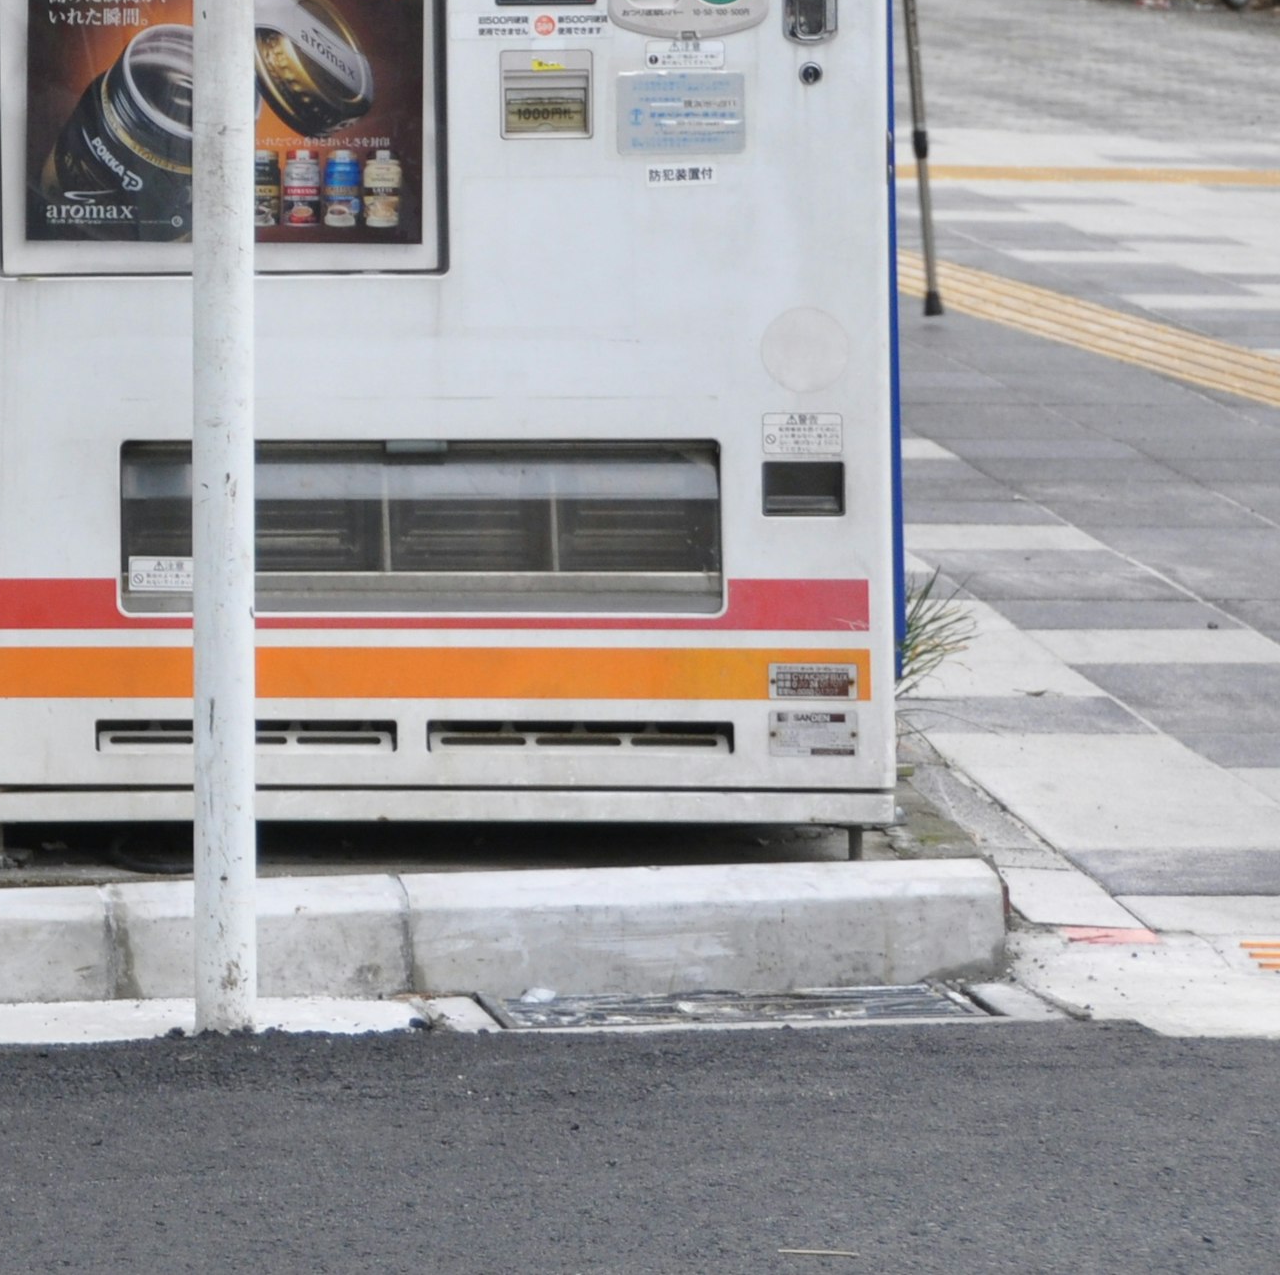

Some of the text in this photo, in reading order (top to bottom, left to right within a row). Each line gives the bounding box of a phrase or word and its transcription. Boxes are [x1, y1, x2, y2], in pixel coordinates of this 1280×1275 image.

[48, 7, 151, 27] いれた瞬間。
[478, 26, 602, 36] 使用できません 使用できます
[300, 27, 357, 81] aromax
[517, 107, 575, 121] 1000円札
[91, 136, 126, 177] POKKA
[648, 167, 713, 182] 防犯装置付
[45, 203, 134, 220] aromax
[793, 712, 830, 723] SANDEN
